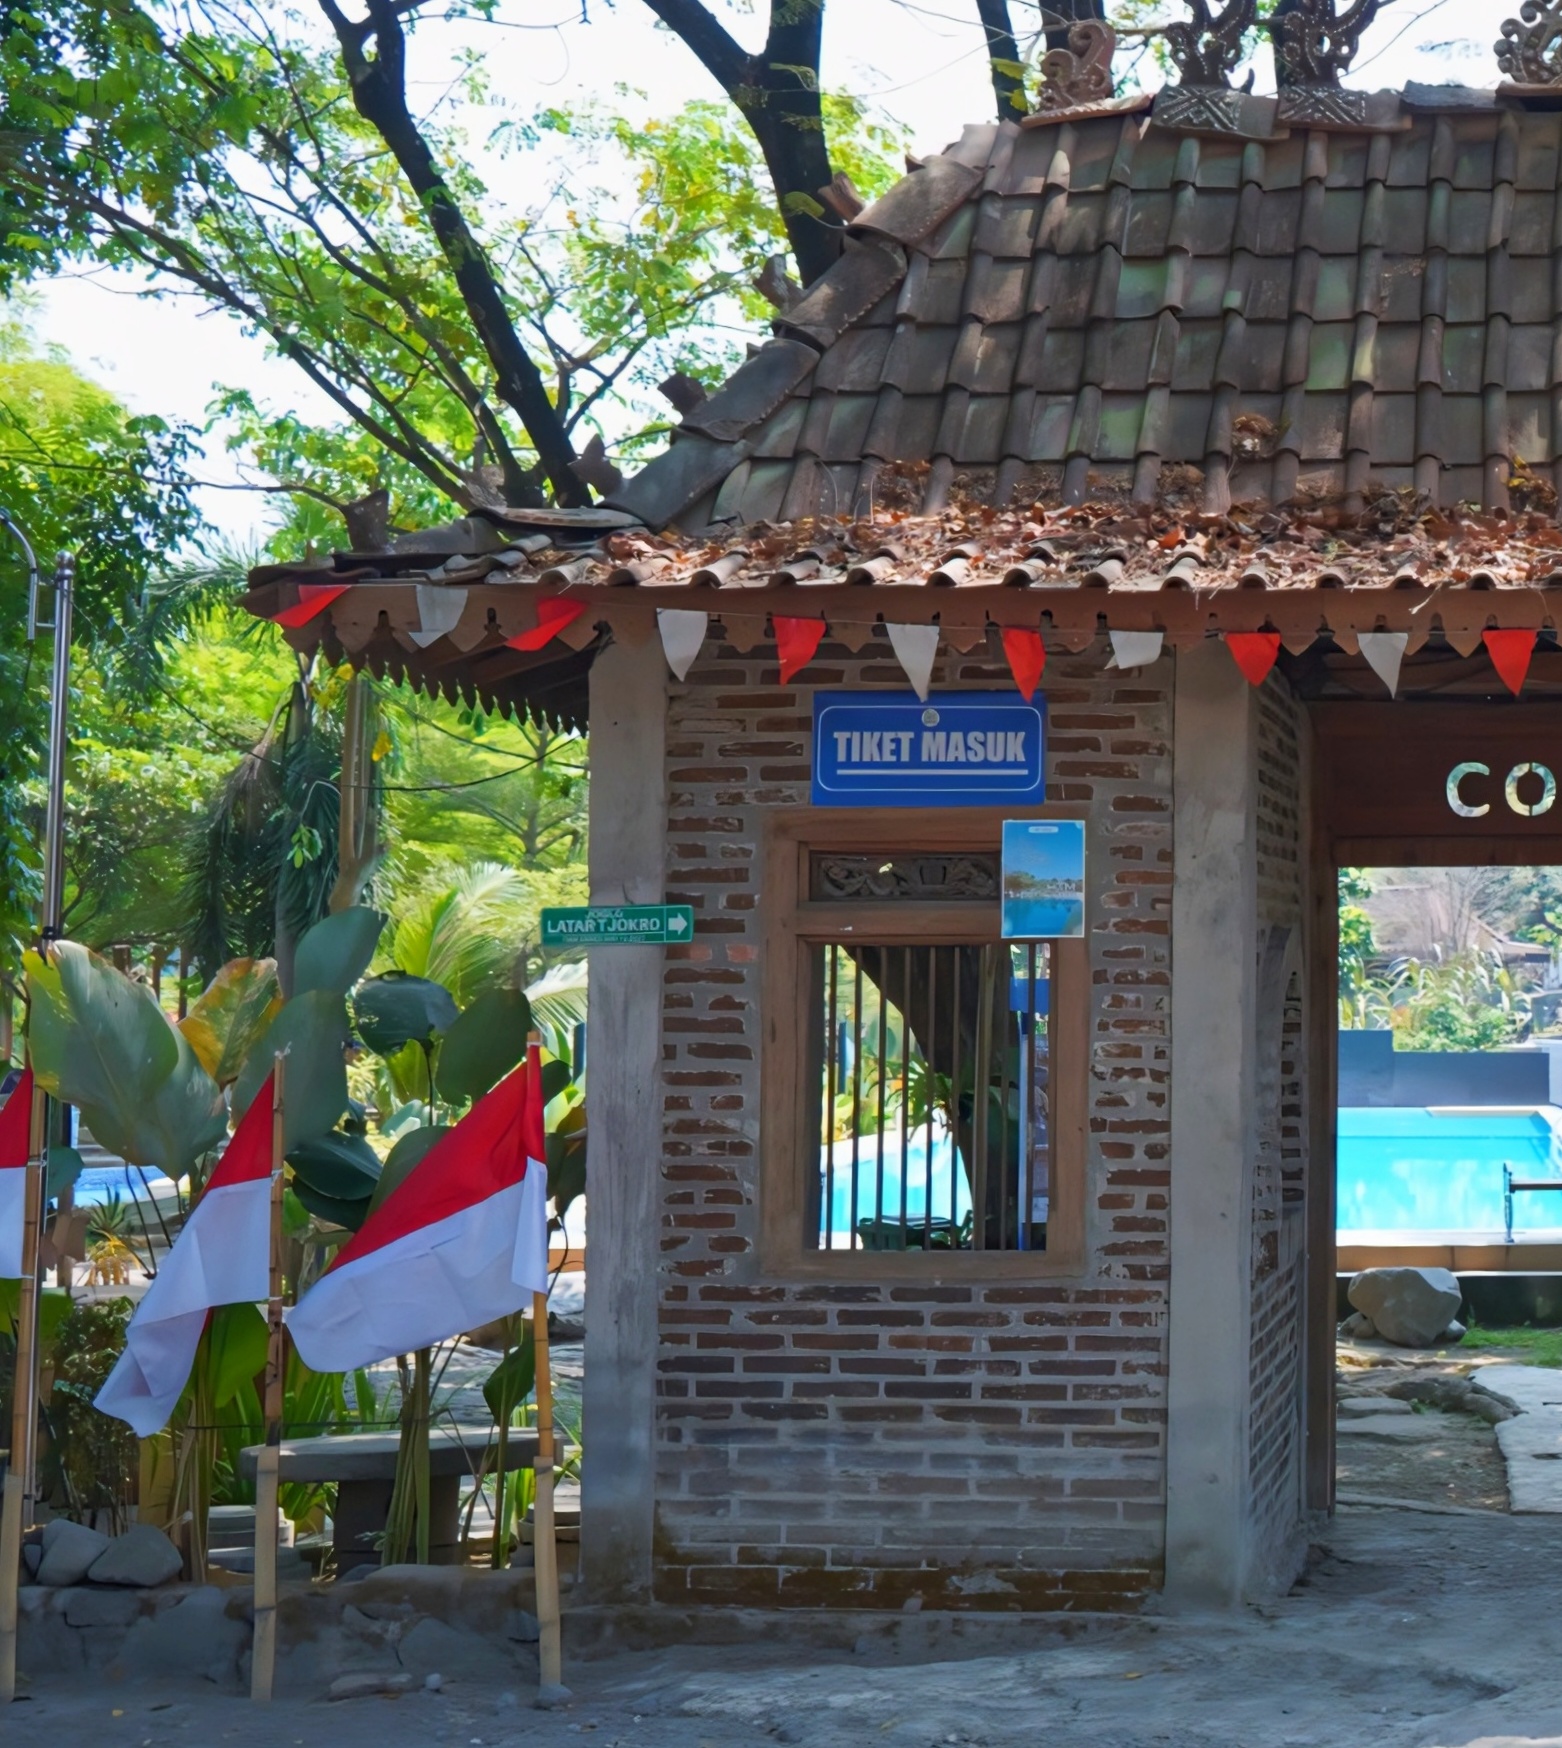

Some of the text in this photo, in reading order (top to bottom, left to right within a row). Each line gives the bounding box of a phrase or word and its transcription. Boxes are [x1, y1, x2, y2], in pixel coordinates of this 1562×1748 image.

[833, 731, 1026, 762] TIKET MASUK
[547, 917, 660, 933] LATAR TJOKRO
